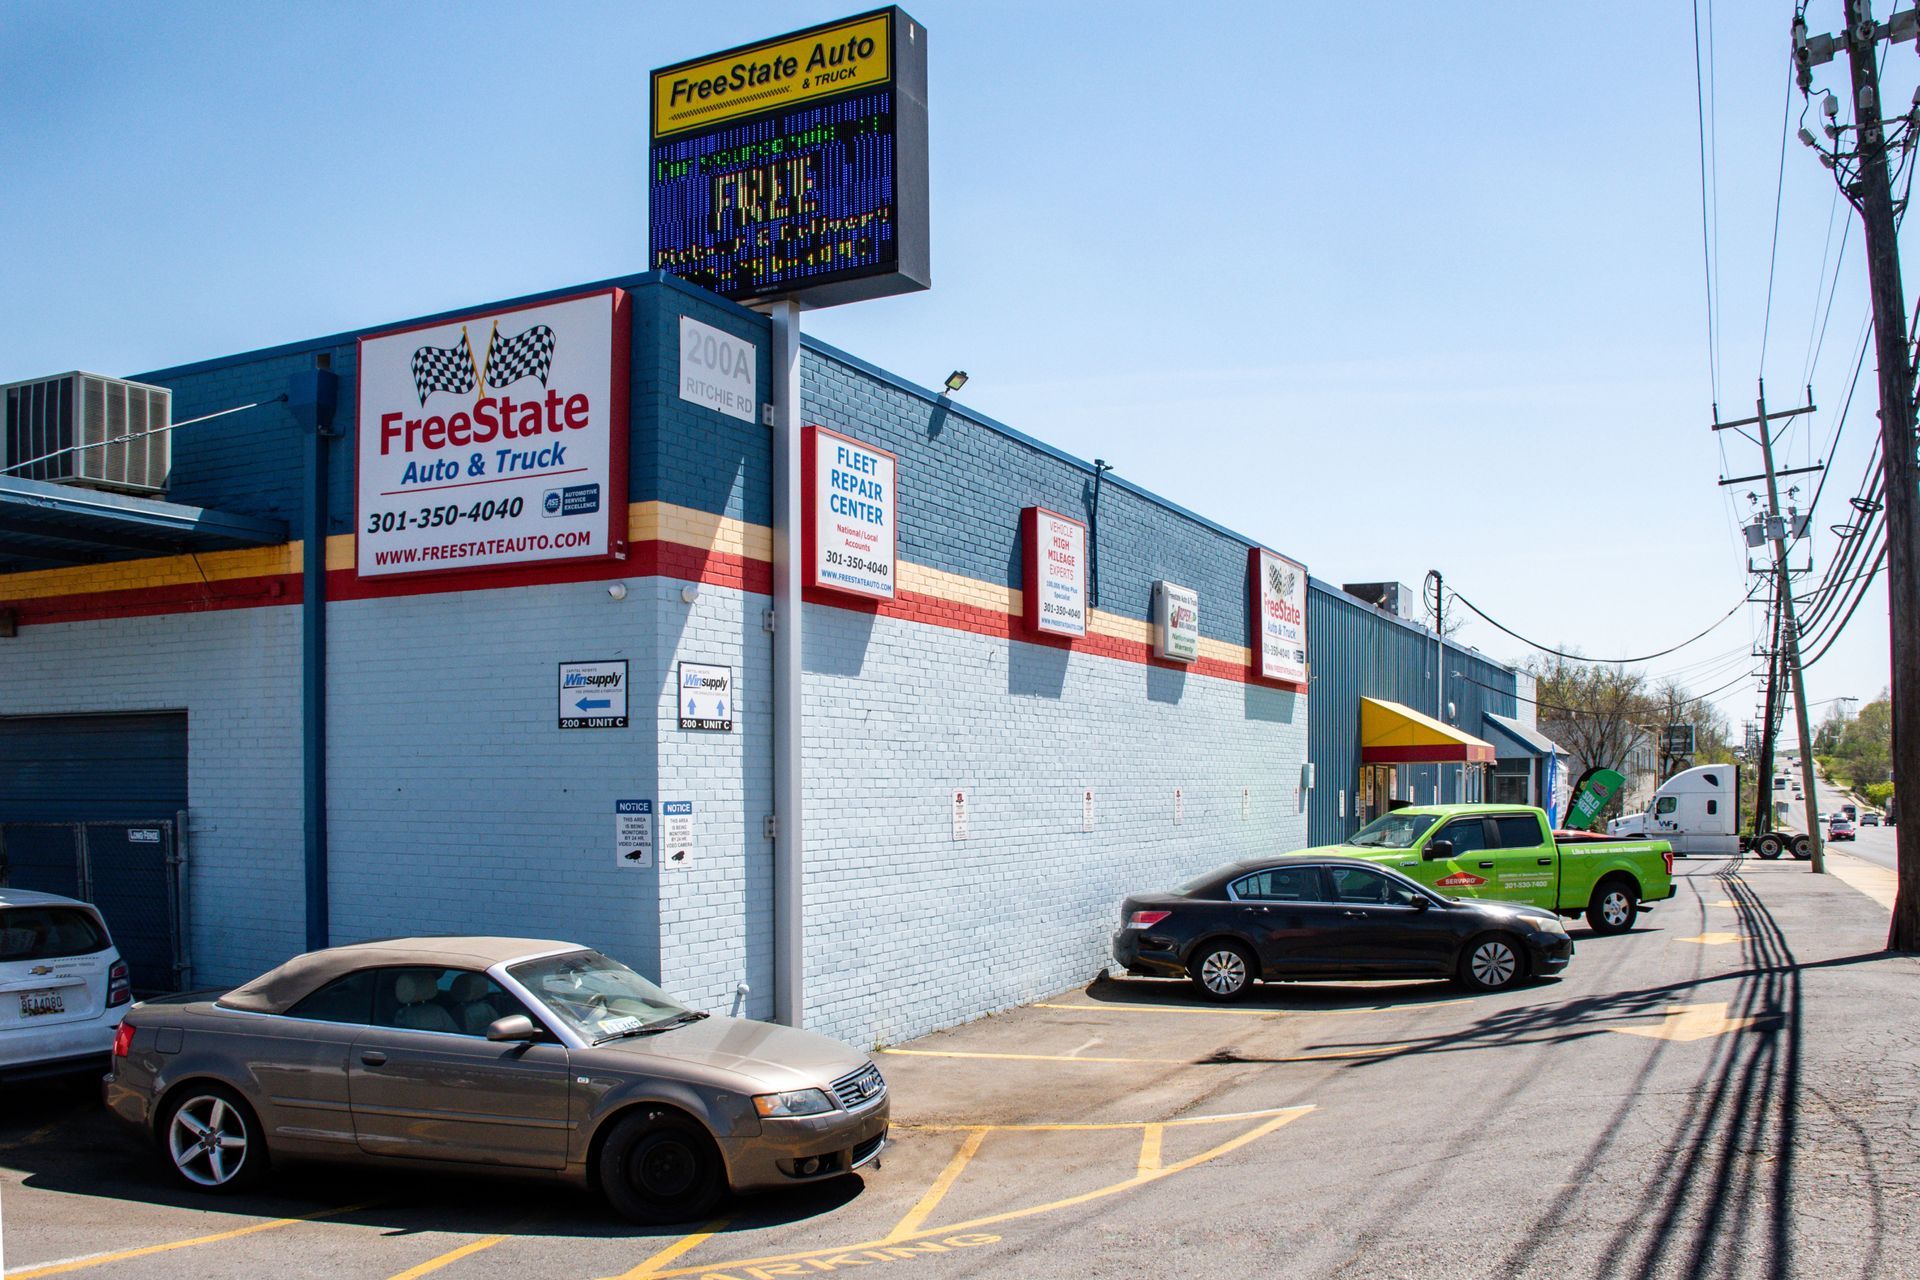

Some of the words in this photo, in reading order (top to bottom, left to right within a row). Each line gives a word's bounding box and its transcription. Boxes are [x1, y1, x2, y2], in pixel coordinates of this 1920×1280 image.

[670, 55, 798, 107] FreeState
[805, 36, 875, 72] Auto
[802, 79, 810, 89] &
[814, 67, 857, 87] TRUCK
[715, 156, 817, 230] FREE
[687, 329, 751, 384] 200A
[686, 377, 733, 407] RITCHIE
[736, 395, 753, 413] RD
[380, 389, 589, 455] FreeState
[401, 458, 459, 485] Auto
[467, 453, 486, 476] &
[496, 441, 567, 474] Truck
[837, 446, 877, 477] FLEET
[565, 488, 598, 498] AUTOMOTIVE
[831, 468, 883, 502] REPAIR
[564, 496, 586, 504] SERVICE
[564, 501, 597, 510] EXCELLENCE
[830, 493, 883, 526] CENTER
[367, 497, 524, 533] 301-350-4040
[837, 524, 878, 543] National/Local
[1049, 520, 1073, 538] VEHICLE
[375, 531, 591, 566] WWW.FREESTATEAUTO.COM
[844, 538, 871, 552] Accounts
[1053, 536, 1070, 551] HIGH
[826, 550, 888, 576] 301-350-4040
[1047, 549, 1076, 567] MILEAGE
[821, 569, 892, 592] WWW.FREESTATEAUTO.COM
[1049, 564, 1074, 581] EXPERTS
[566, 671, 621, 688] Winsupply
[685, 673, 727, 691] Winsupply
[562, 719, 579, 728] 200
[588, 718, 614, 728] UNIT
[616, 717, 624, 727] C
[682, 719, 697, 728] 200
[703, 720, 722, 729] UNIT
[723, 721, 730, 730] C
[619, 802, 649, 811] NOTICE
[667, 804, 691, 812] NOTICE
